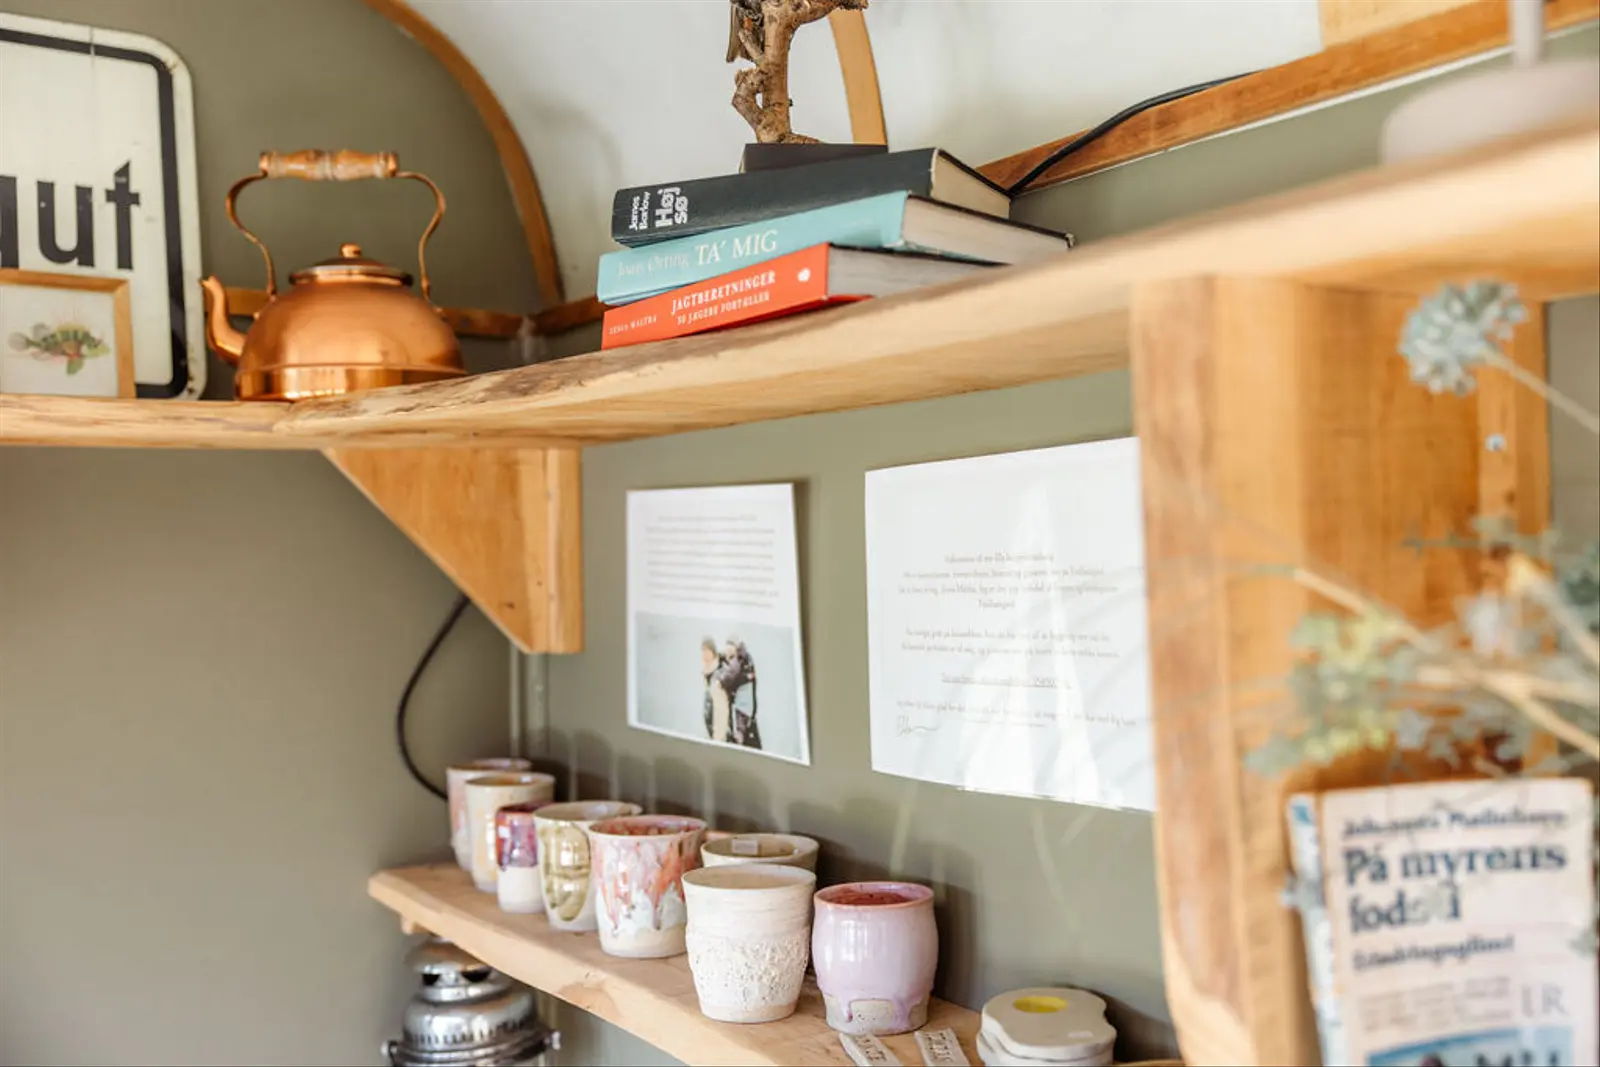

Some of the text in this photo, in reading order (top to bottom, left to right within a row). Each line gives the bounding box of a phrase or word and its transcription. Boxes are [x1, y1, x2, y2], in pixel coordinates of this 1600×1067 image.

[628, 195, 641, 231] James
[655, 187, 681, 228] Høj
[674, 196, 688, 224] sø
[731, 229, 778, 260] MIG
[671, 269, 776, 316] JAGTBERETNINGER
[1344, 843, 1567, 886] På myrens
[1349, 888, 1461, 934] fodi
